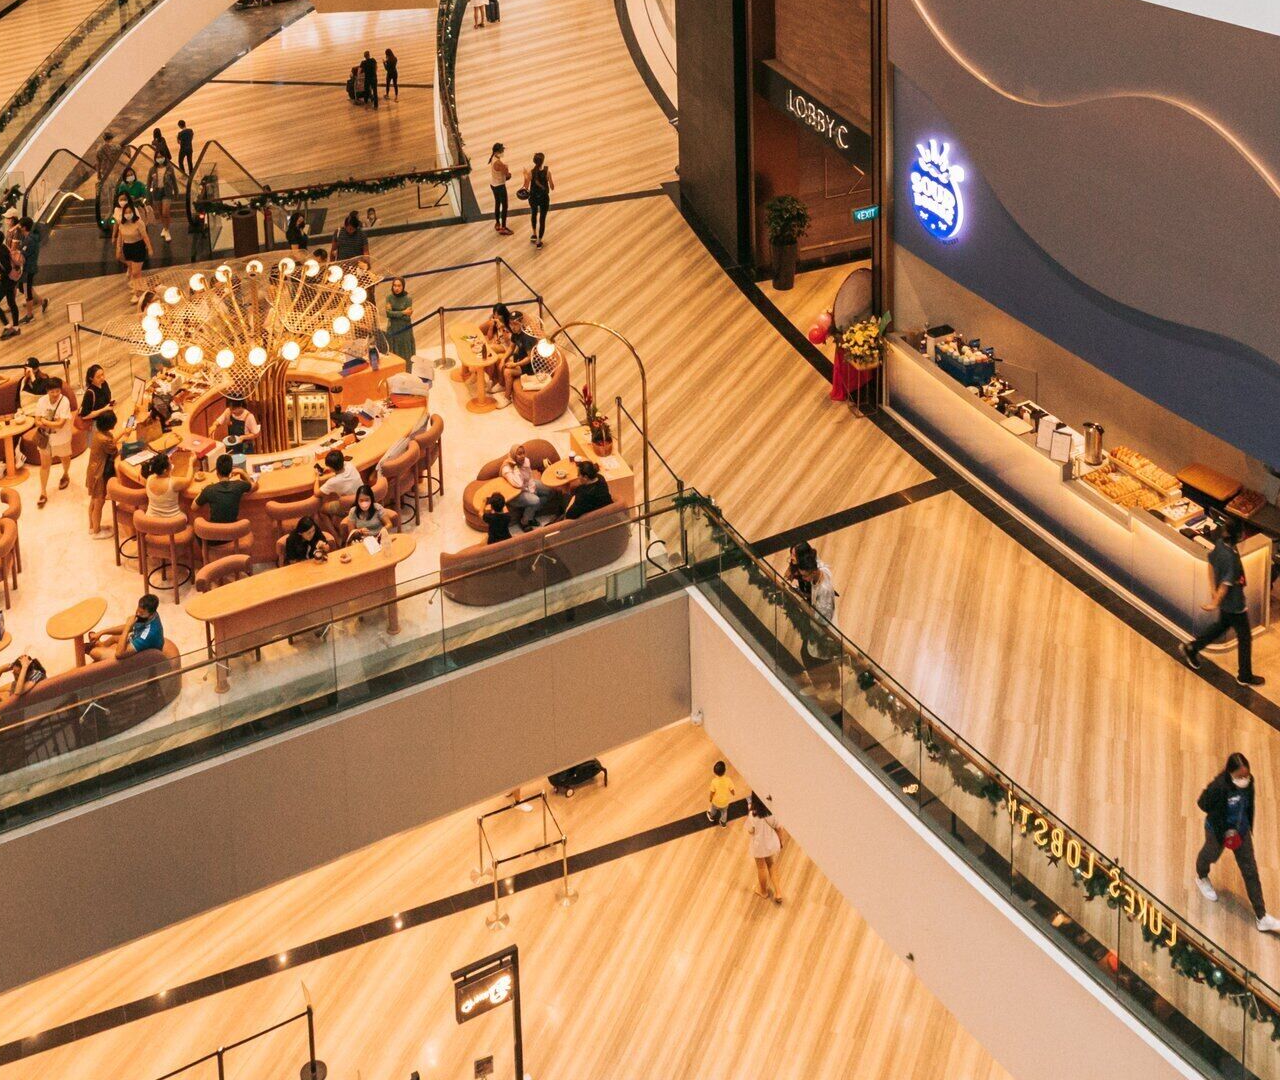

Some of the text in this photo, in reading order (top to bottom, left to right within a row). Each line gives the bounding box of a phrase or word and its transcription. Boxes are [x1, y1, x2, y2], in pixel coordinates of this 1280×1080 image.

[786, 89, 849, 149] LOBBY C
[417, 181, 449, 209] L2
[860, 208, 876, 220] EXIT
